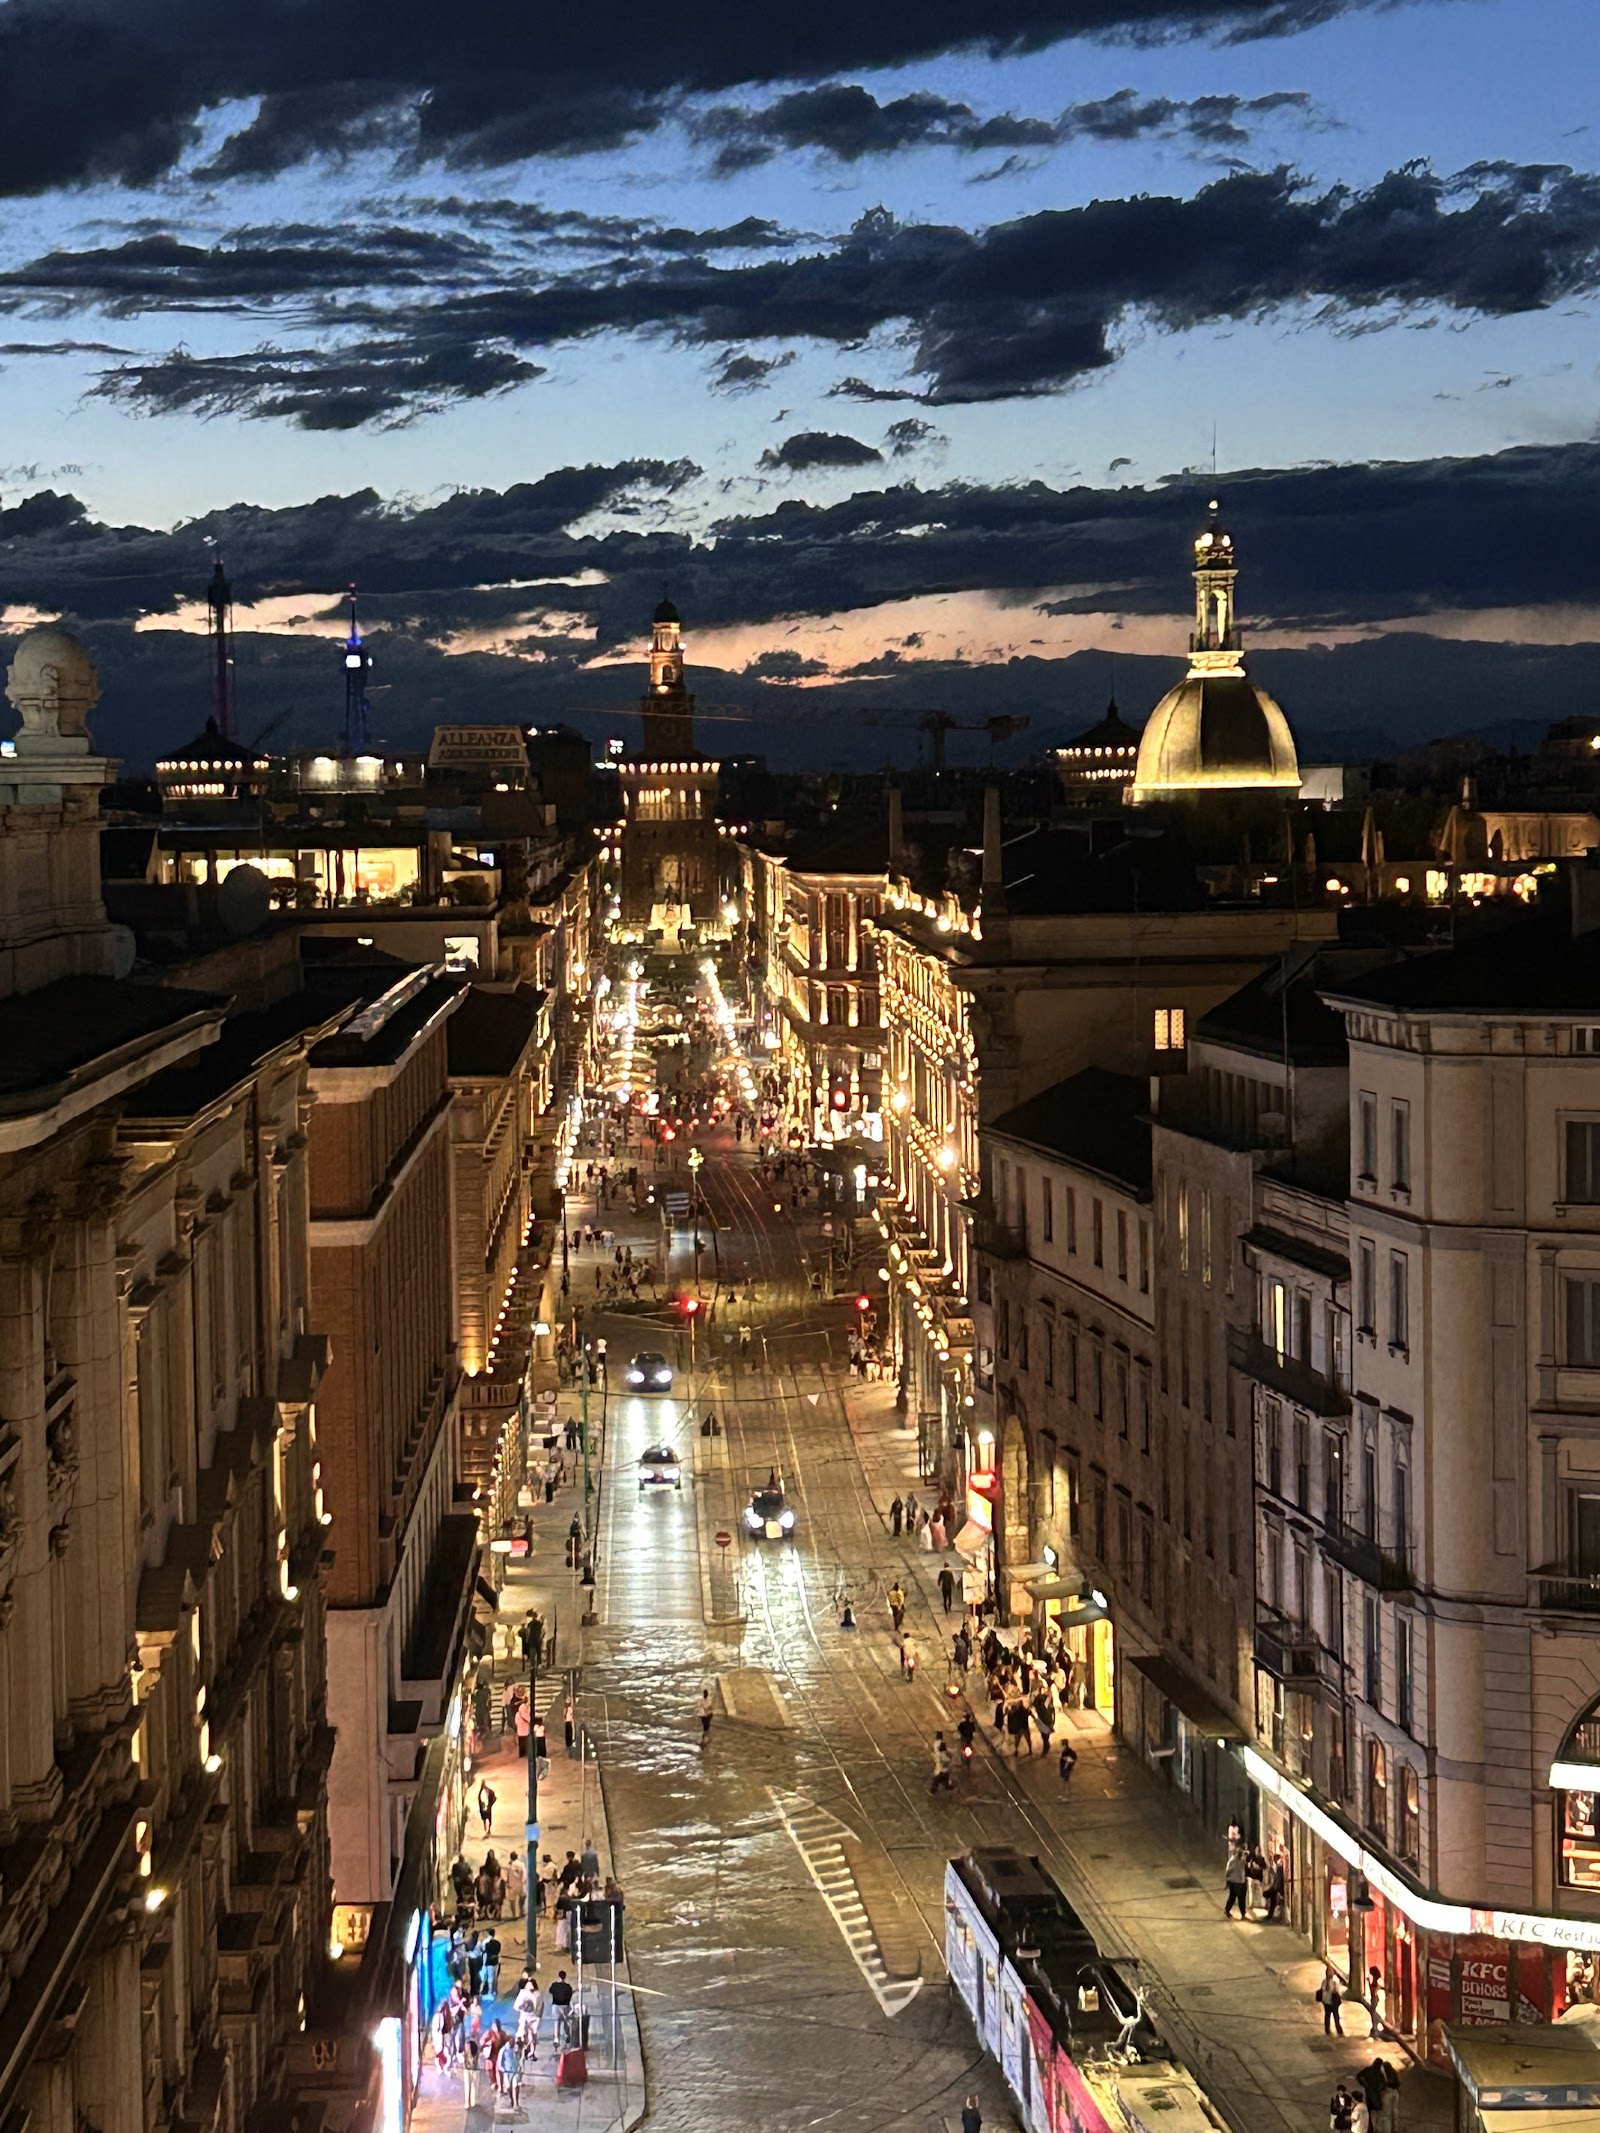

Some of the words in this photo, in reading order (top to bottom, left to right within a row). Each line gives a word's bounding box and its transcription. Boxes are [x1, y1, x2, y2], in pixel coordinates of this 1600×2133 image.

[439, 732, 520, 746] ALLEANZA
[1501, 1919, 1545, 1937] KFC
[1461, 1960, 1507, 1981] KFC
